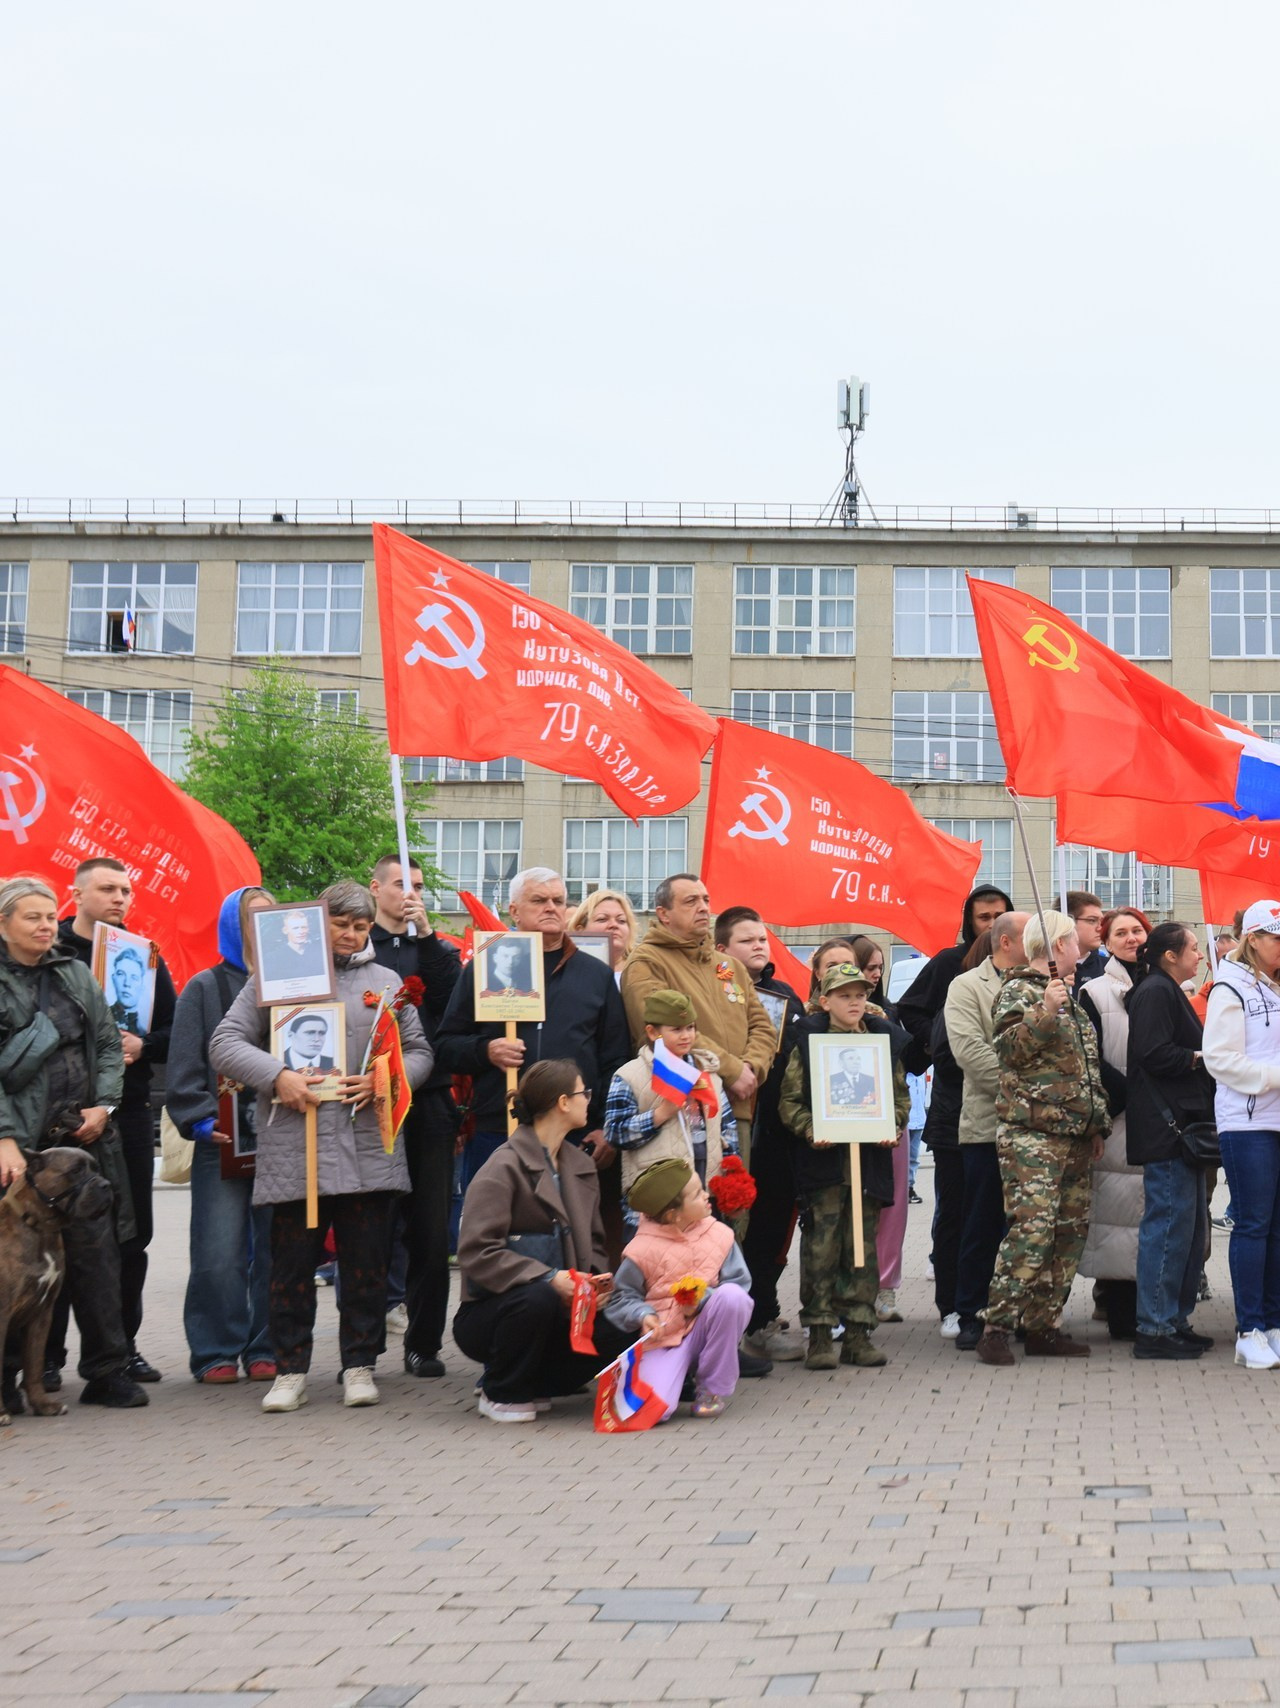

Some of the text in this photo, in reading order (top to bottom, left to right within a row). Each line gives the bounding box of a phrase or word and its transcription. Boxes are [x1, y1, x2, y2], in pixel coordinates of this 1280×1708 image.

[512, 604, 541, 630] 150
[539, 702, 581, 743] 79
[69, 797, 99, 825] 150
[811, 796, 831, 817] 150
[831, 867, 860, 903] 79
